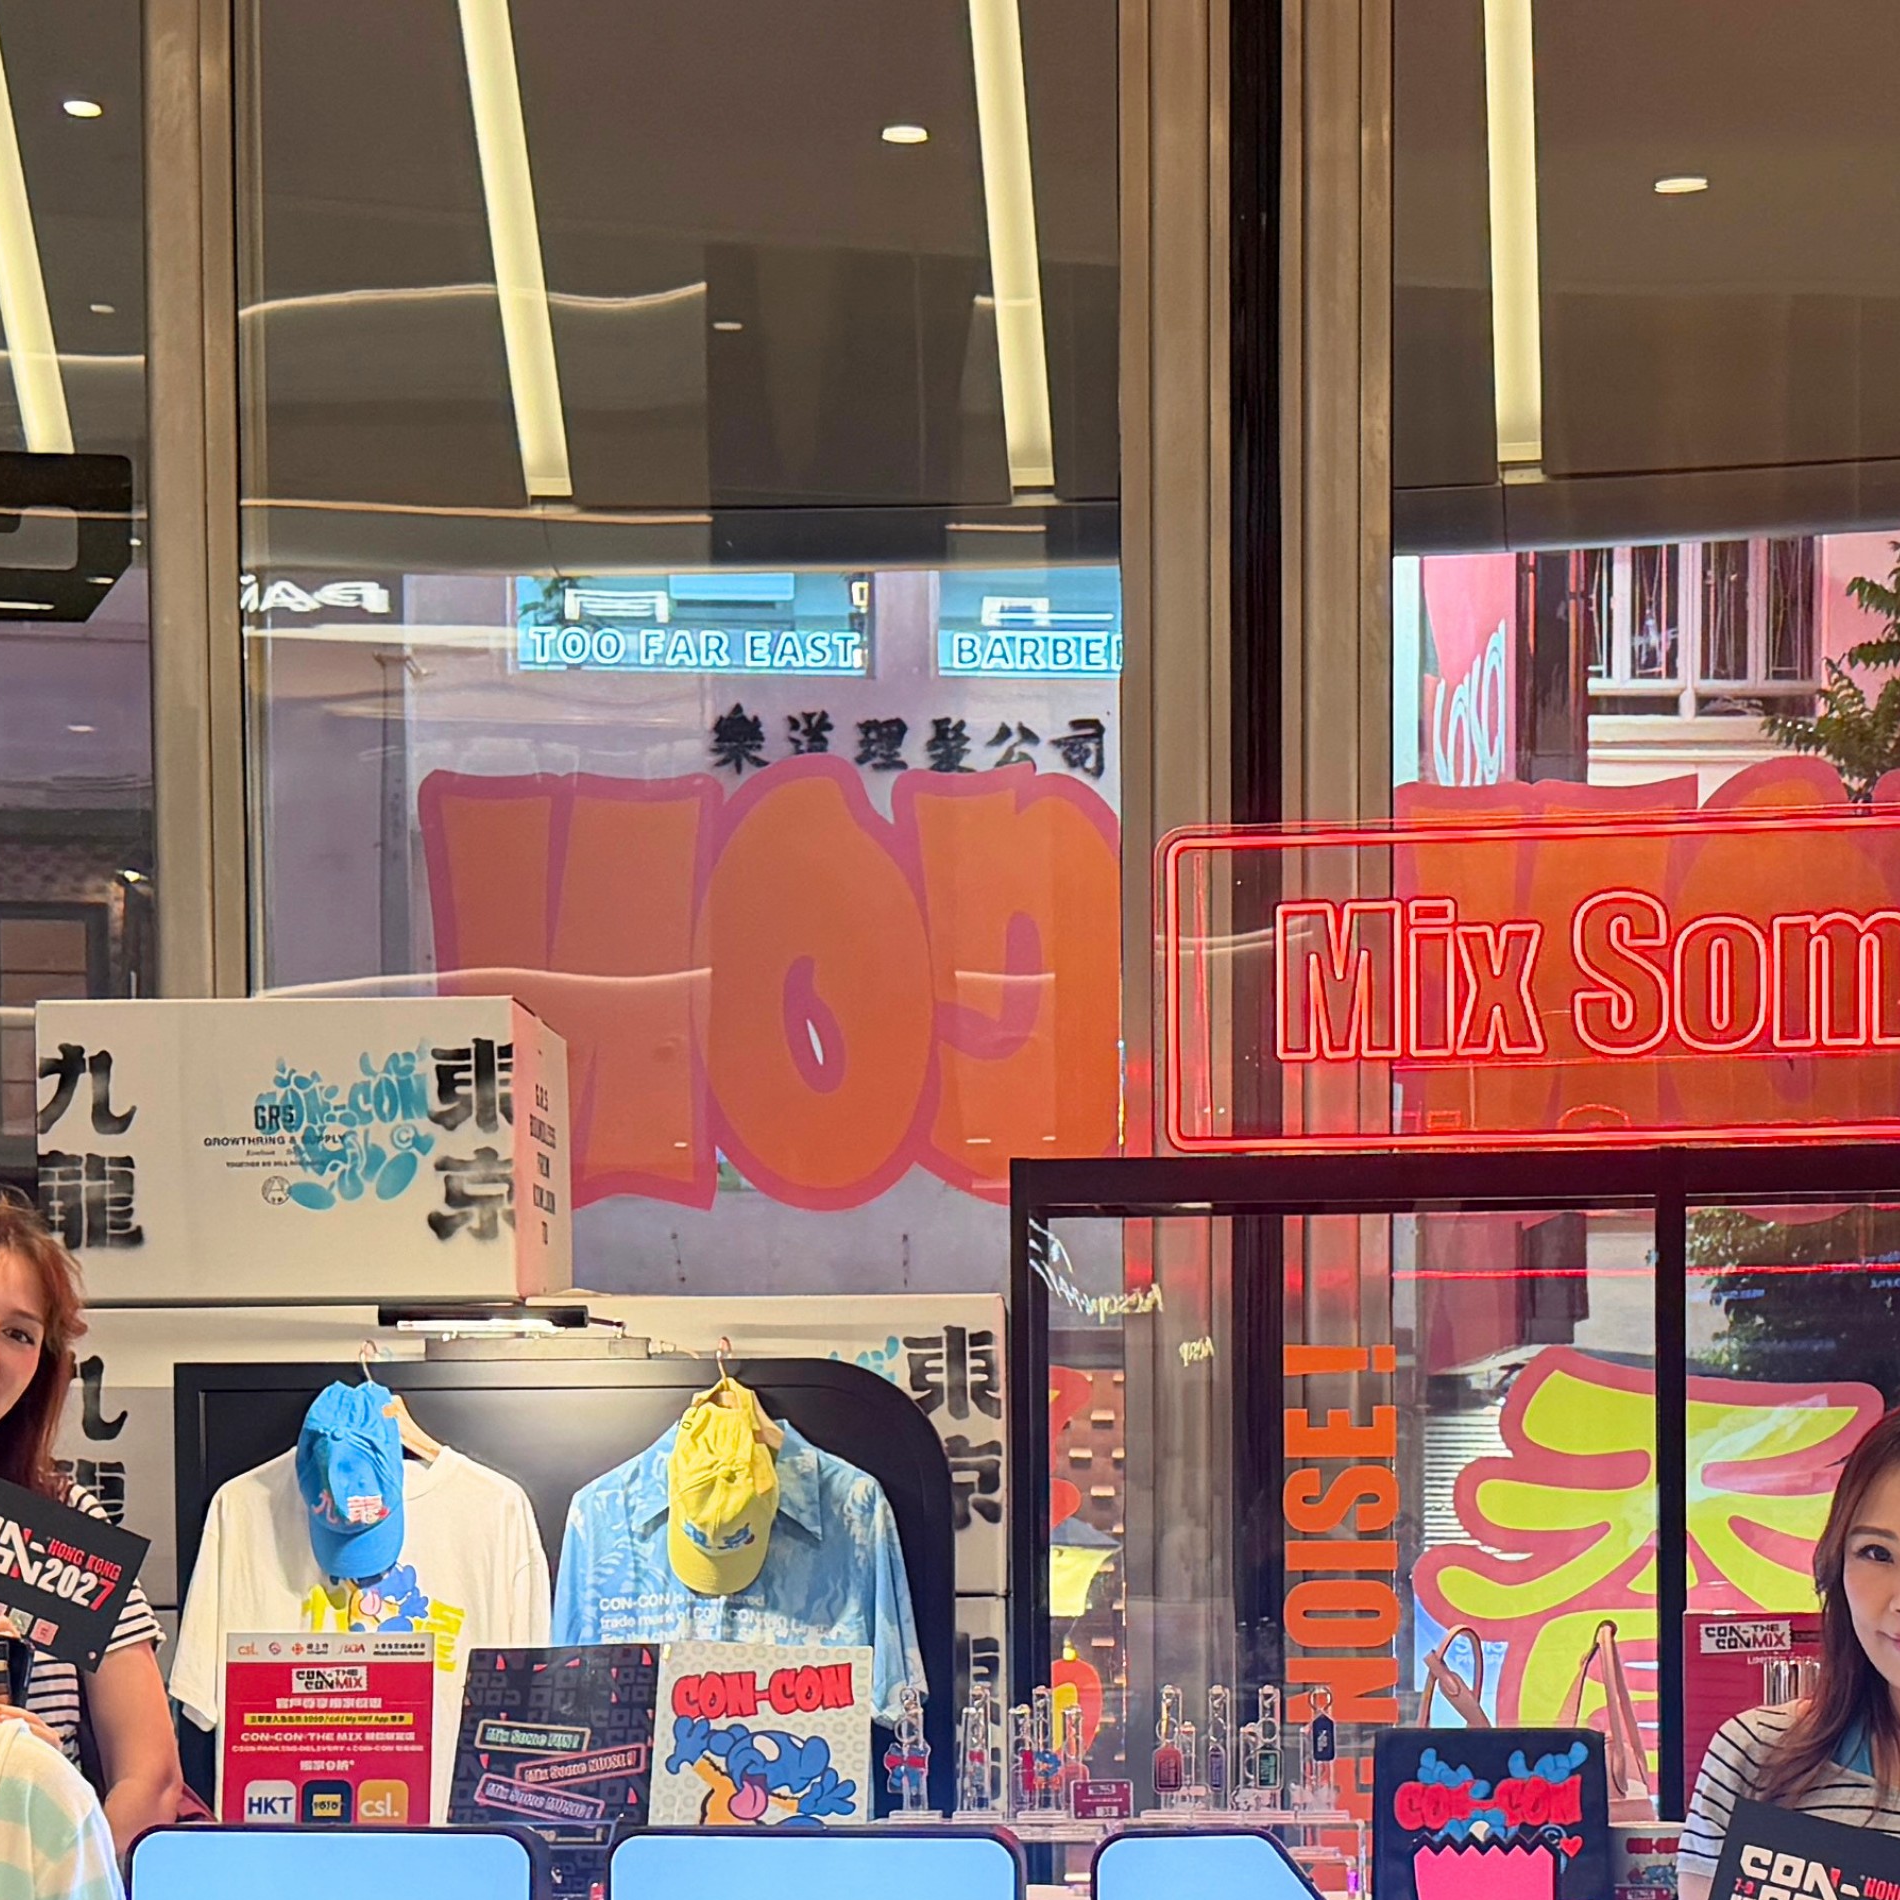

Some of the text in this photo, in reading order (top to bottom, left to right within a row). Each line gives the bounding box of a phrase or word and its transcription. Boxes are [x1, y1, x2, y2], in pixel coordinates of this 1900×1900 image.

[530, 628, 861, 669] TOO FAR EAST
[1274, 897, 1547, 1062] Mix
[48, 1537, 83, 1566] HONG
[86, 1554, 122, 1581] KONG
[37, 1559, 116, 1611] 2027
[672, 1662, 855, 1720] CON-CON
[248, 1796, 293, 1815] HKT
[360, 1792, 400, 1818] csl.
